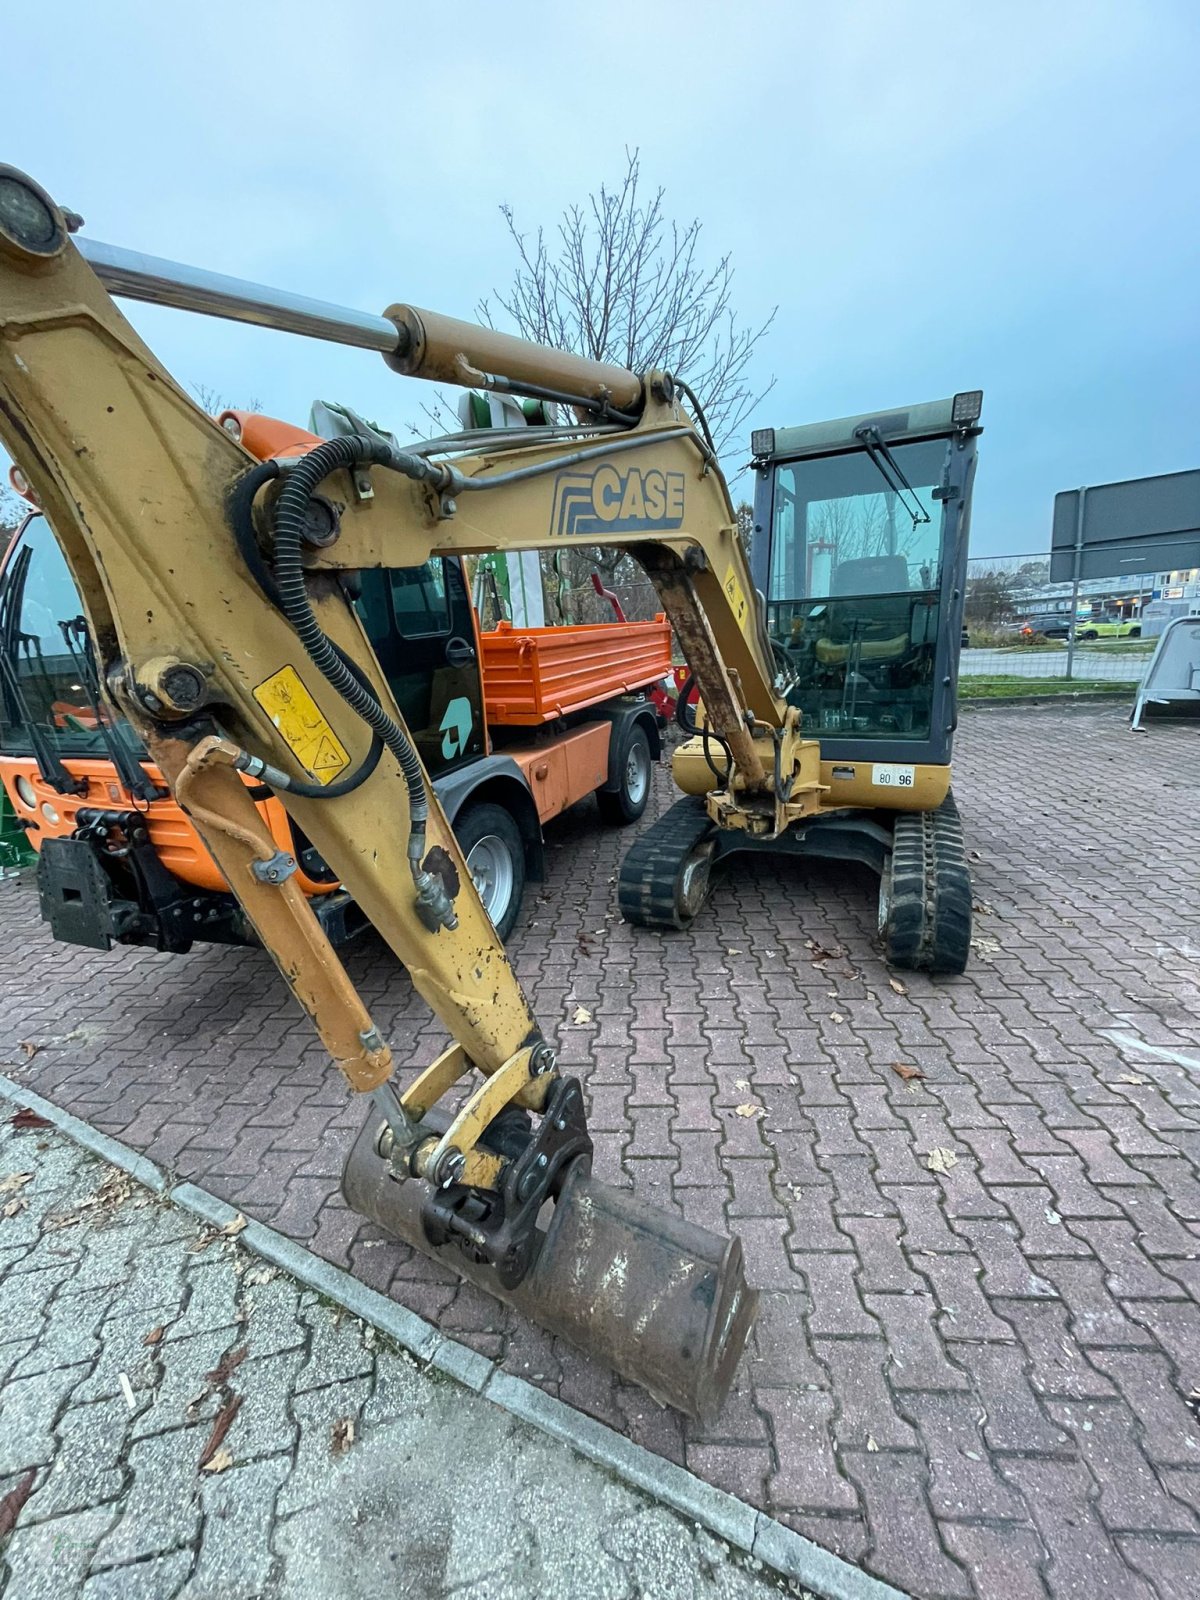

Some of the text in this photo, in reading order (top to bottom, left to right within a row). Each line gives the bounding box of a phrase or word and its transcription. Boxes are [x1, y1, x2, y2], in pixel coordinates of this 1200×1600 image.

[592, 464, 685, 521] CASE
[880, 773, 912, 786] 80 96
